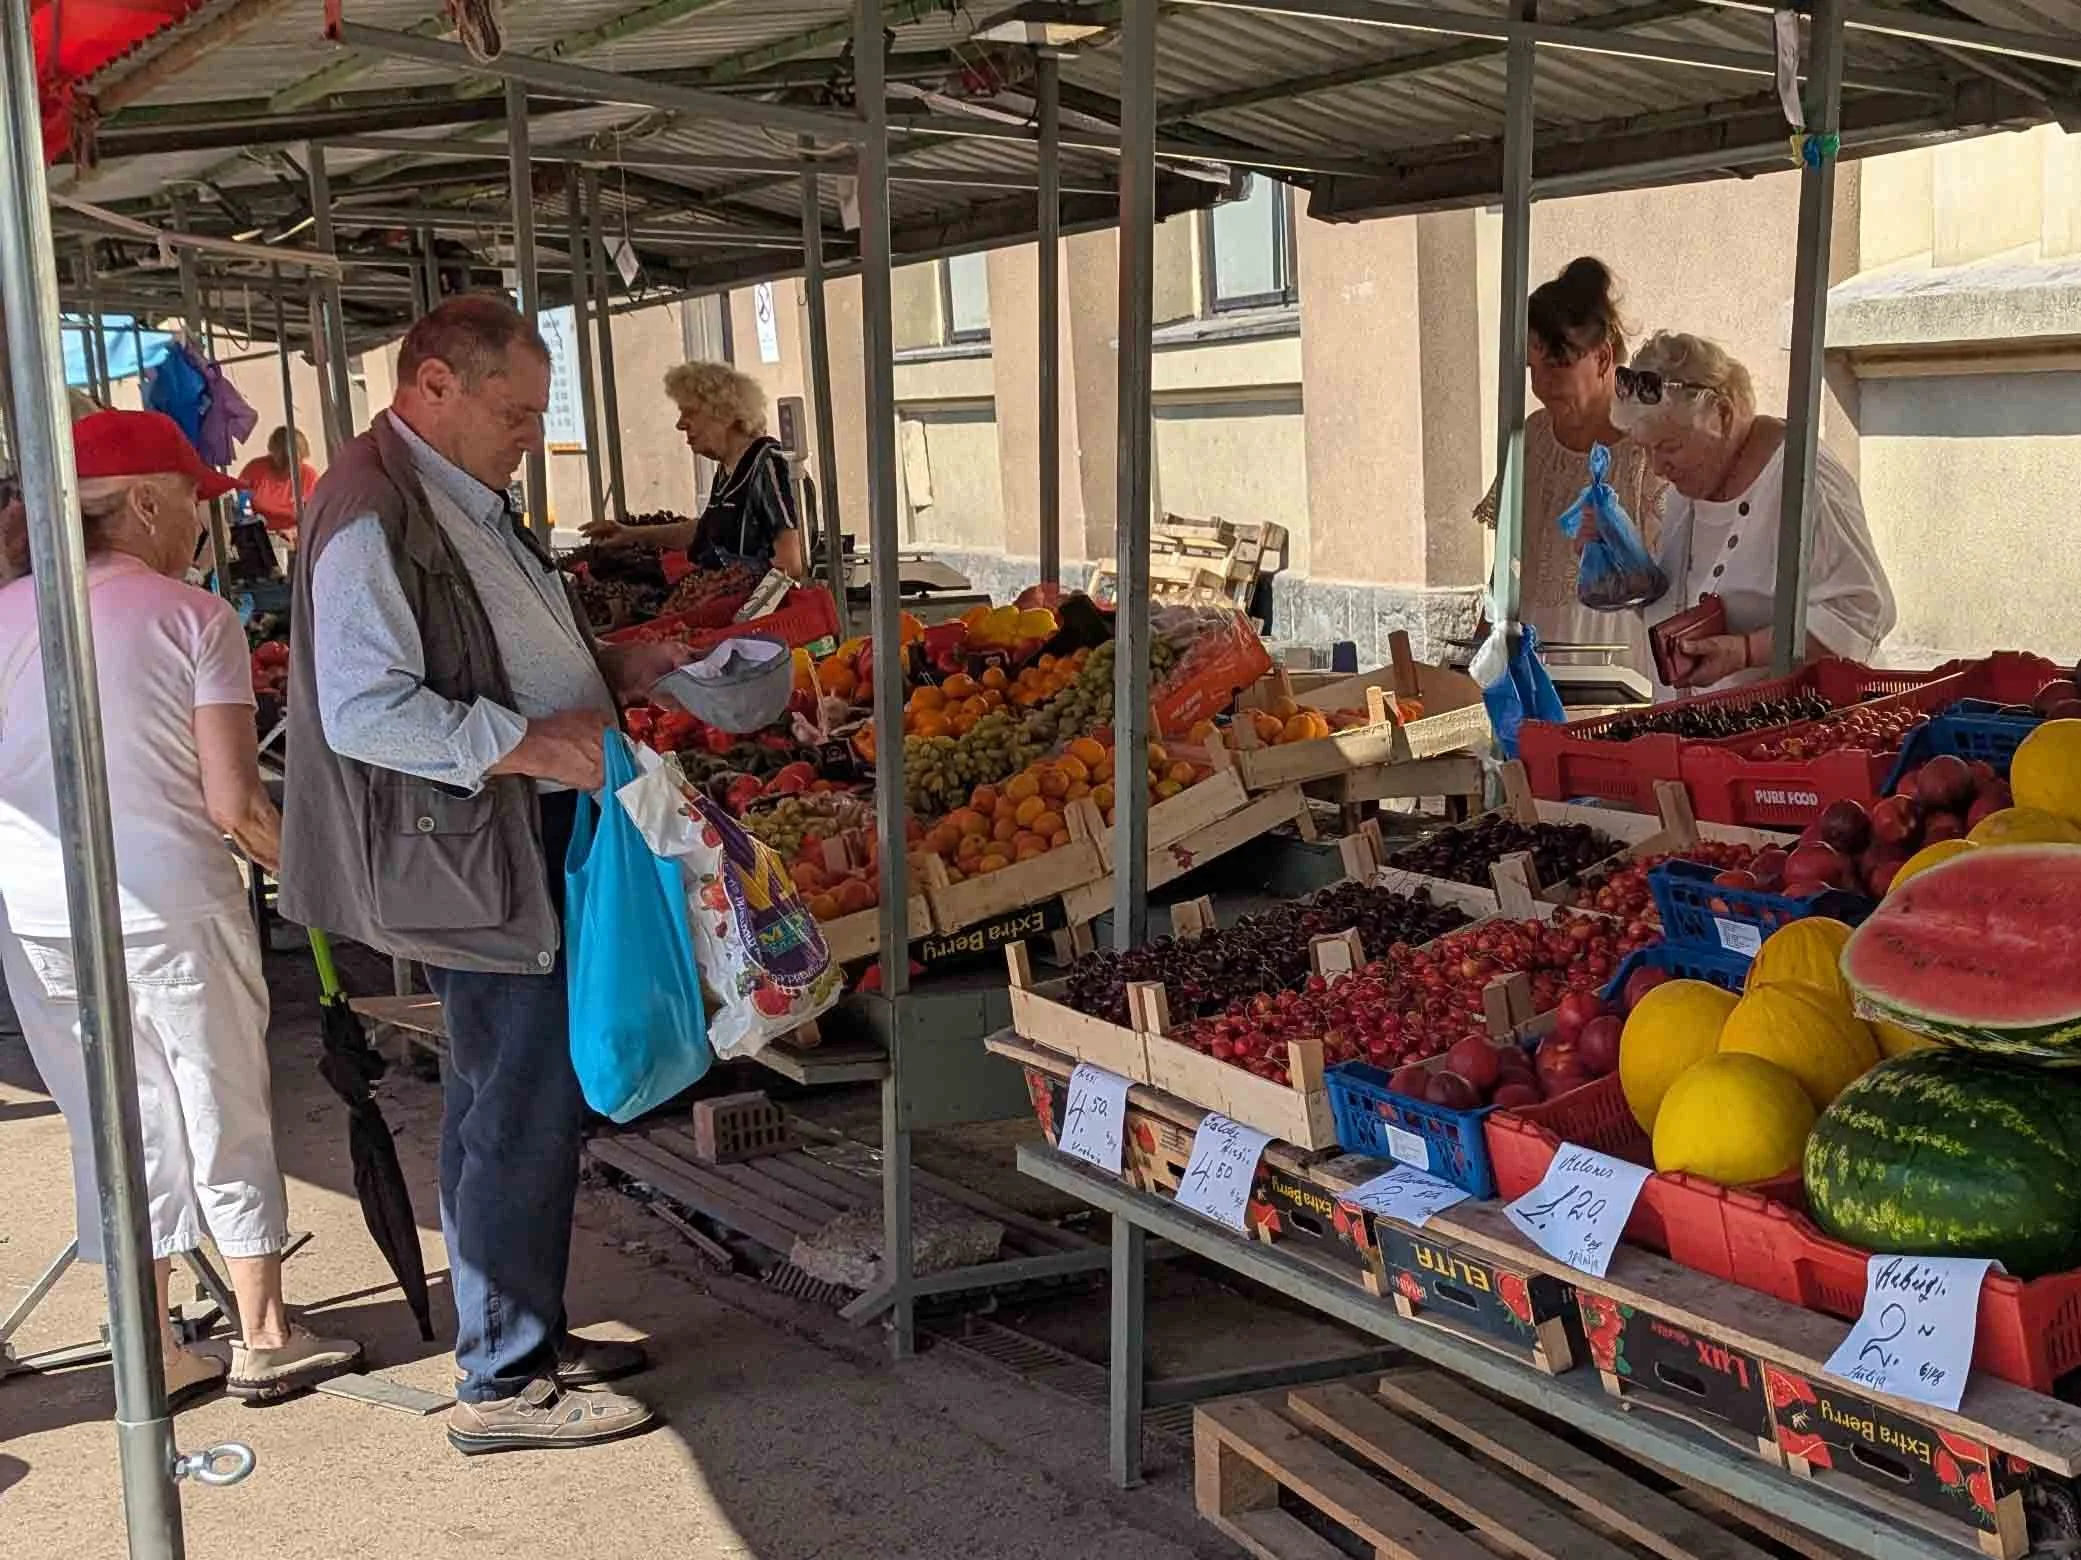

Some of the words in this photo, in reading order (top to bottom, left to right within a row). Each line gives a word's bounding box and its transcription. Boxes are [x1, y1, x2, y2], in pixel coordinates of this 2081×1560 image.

[1754, 789, 1786, 805] PURE
[1787, 791, 1819, 806] FOOD
[988, 911, 1046, 941] Extra
[922, 930, 985, 961] Berry
[1270, 1175, 1303, 1207] Berry
[1303, 1191, 1333, 1220] Extra
[1409, 1241, 1491, 1293] ELITA
[1820, 1399, 1876, 1443] Berry
[1879, 1422, 1932, 1465] Extra
